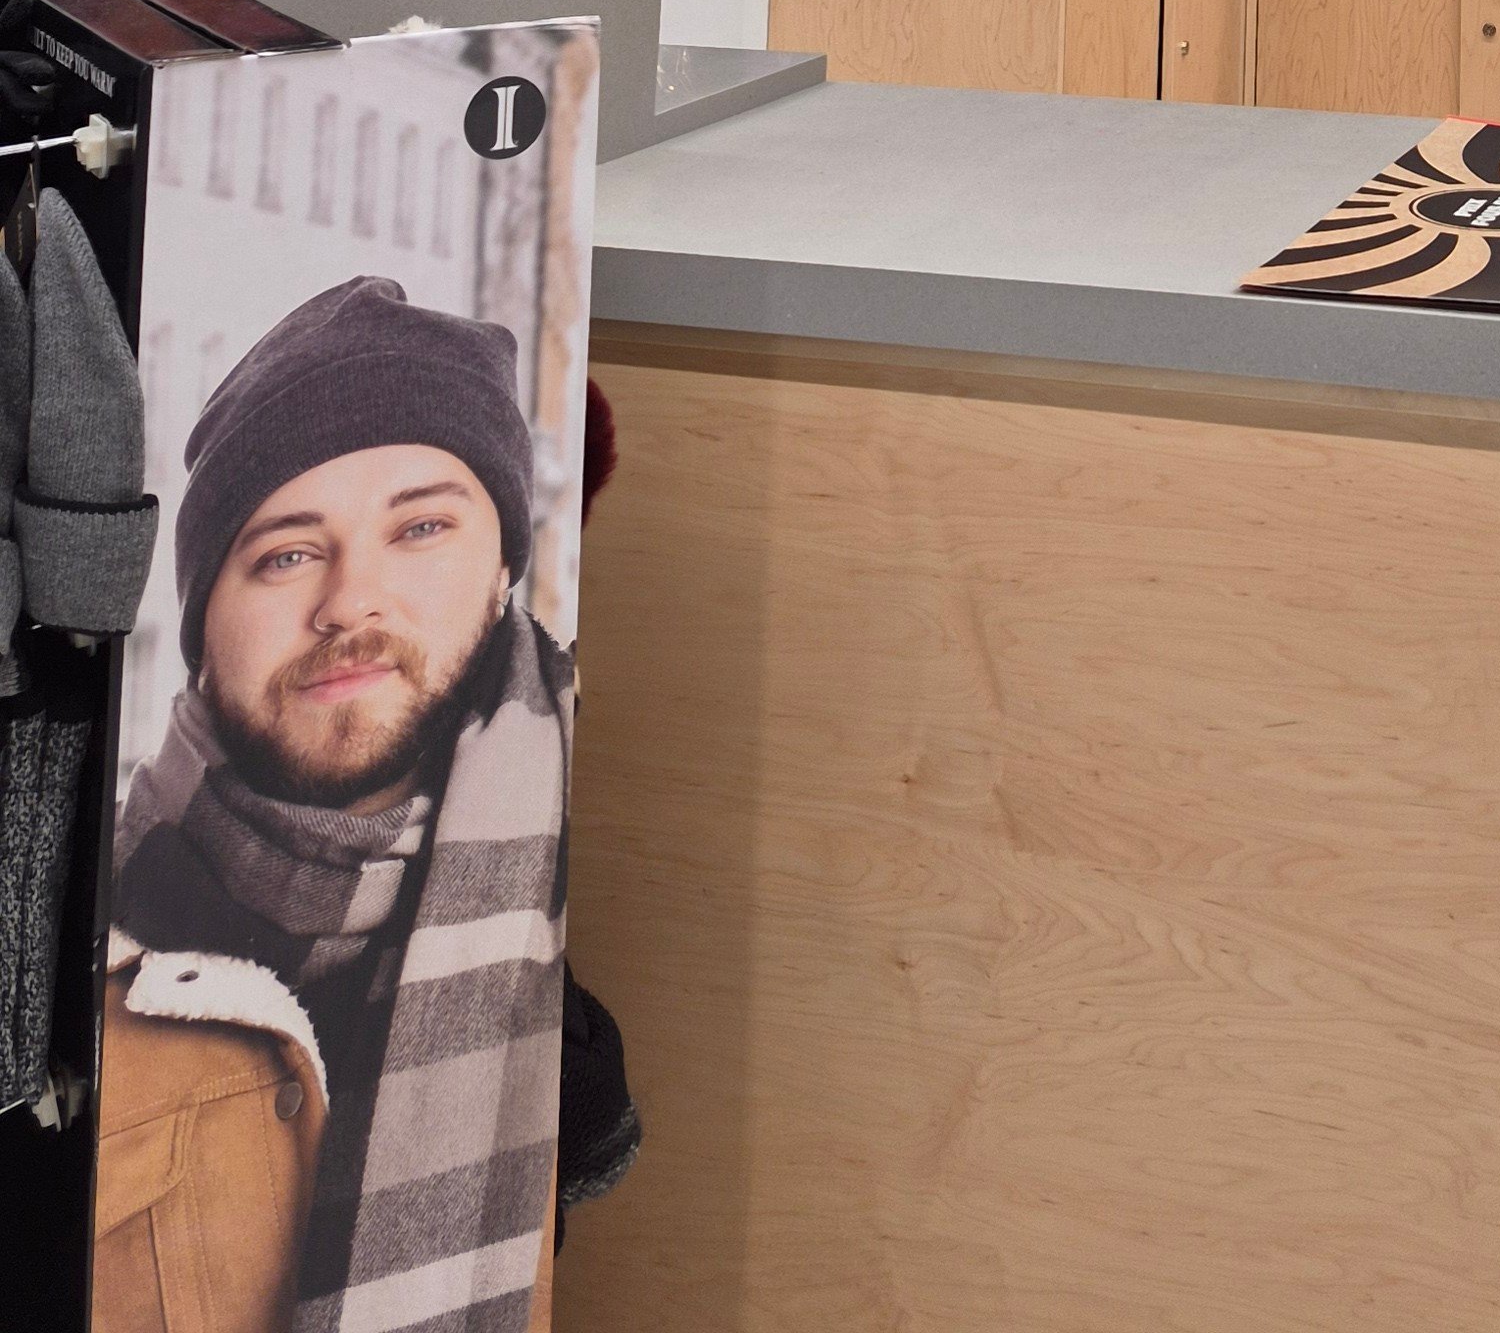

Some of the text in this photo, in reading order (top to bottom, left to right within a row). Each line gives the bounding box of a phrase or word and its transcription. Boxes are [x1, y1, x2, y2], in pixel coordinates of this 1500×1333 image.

[46, 34, 56, 58] TO
[56, 42, 74, 70] KEEP
[74, 52, 91, 81] YOU
